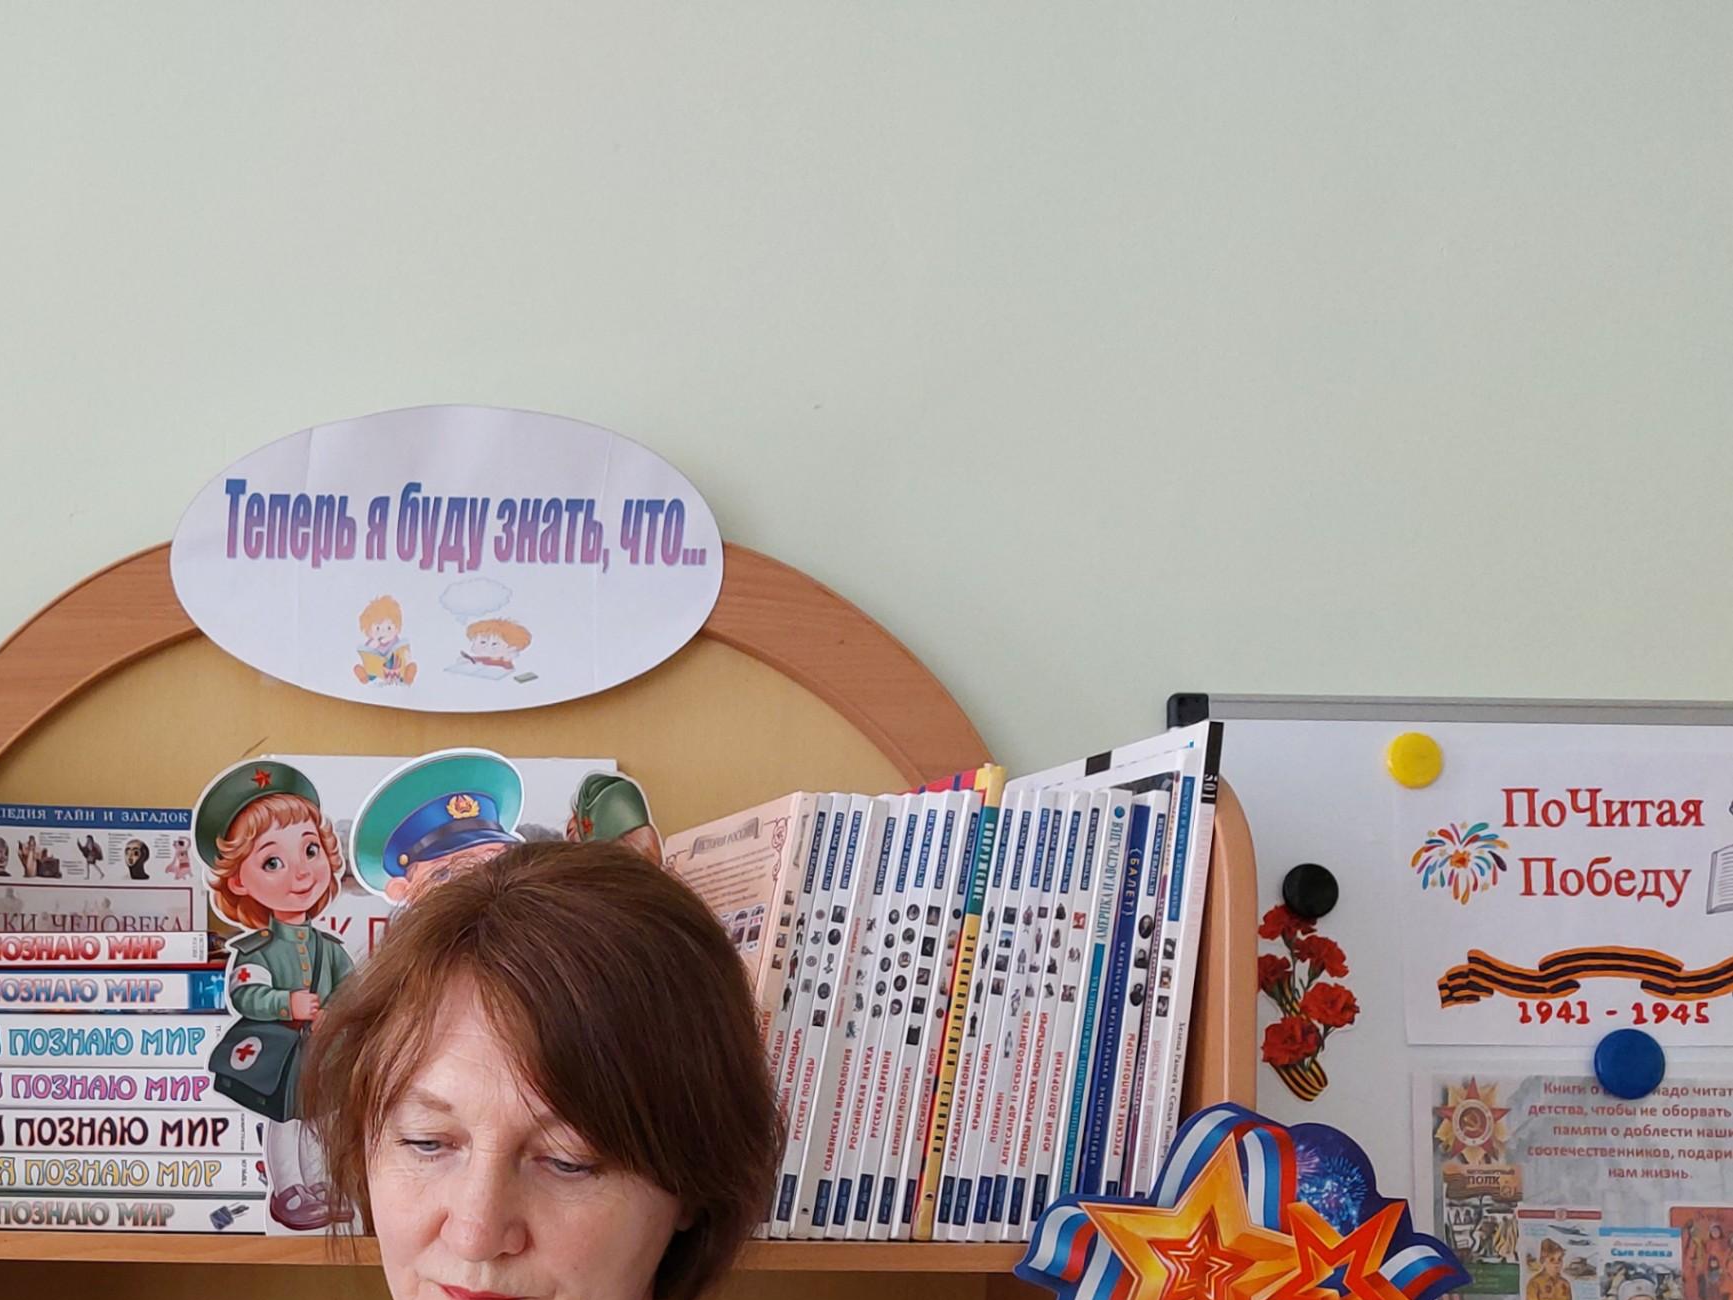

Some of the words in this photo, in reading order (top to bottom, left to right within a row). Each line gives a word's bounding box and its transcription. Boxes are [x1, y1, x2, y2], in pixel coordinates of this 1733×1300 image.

[224, 478, 357, 569] Теперь
[365, 496, 389, 561] я
[397, 481, 490, 573] буду
[494, 497, 611, 573] знать,
[619, 498, 708, 567] что...
[54, 808, 96, 822] ТАЙН
[103, 811, 113, 822] И
[121, 811, 189, 824] ЗАГАДОК
[1502, 788, 1704, 828] ПоЧитая
[1520, 857, 1692, 907] Победу
[106, 935, 166, 960] МИР
[1518, 1001, 1591, 1025] 1941
[1631, 1001, 1710, 1025] 1945
[8, 1027, 134, 1056] ПОЗНАЮ
[141, 1027, 205, 1055] МИР
[1032, 1012, 1048, 1076] МОНАСТЫРЕЙ
[11, 1074, 137, 1101] ПОЗНАЮ
[145, 1074, 210, 1101] МИР
[877, 1051, 893, 1093] ДЕРЕВНЯ
[972, 1078, 986, 1131] КРЫМСКАЯ
[980, 1043, 992, 1076] ВОЙНА
[1001, 1105, 1017, 1166] АЛЕКСАНДР
[1012, 1010, 1032, 1092] ОСВОБОДИТЕЛЬ
[1543, 1082, 1587, 1096] Книги
[824, 1111, 841, 1172] СЛАВЯНСКАЯ
[834, 1048, 853, 1108] МИФОЛОГИЯ
[847, 1084, 867, 1150] РОССИЙСКАЯ
[861, 1046, 874, 1080] НАУКА
[949, 1089, 967, 1162] ГРАЖДАНСКАЯ
[961, 1052, 972, 1086] ВОЙНА
[1026, 1080, 1039, 1122] РУССКИХ
[1112, 1113, 1126, 1156] РУССКИЕ
[1119, 1033, 1136, 1110] КОМПОЗИТОРЫ
[1528, 1104, 1587, 1118] детства,
[1591, 1103, 1637, 1117] чтобы
[1640, 1106, 1657, 1117] не
[1662, 1105, 1732, 1119] оборвать
[15, 1116, 149, 1147] ПОЗНАЮ
[160, 1117, 230, 1148] МИР
[870, 1096, 885, 1138] РУССКАЯ
[1553, 1125, 1607, 1137] памяти
[1611, 1127, 1620, 1137] о
[1623, 1125, 1693, 1139] доблести
[1019, 1125, 1032, 1167] ЛЕГЕНДЫ
[1527, 1147, 1675, 1160] соотечественников,
[25, 1159, 150, 1187] ПОЗНАЮ
[157, 1159, 222, 1188] МИР
[1468, 1175, 1500, 1185] ПОЛК
[1608, 1168, 1637, 1179] нам
[1640, 1168, 1693, 1179] жизнь.
